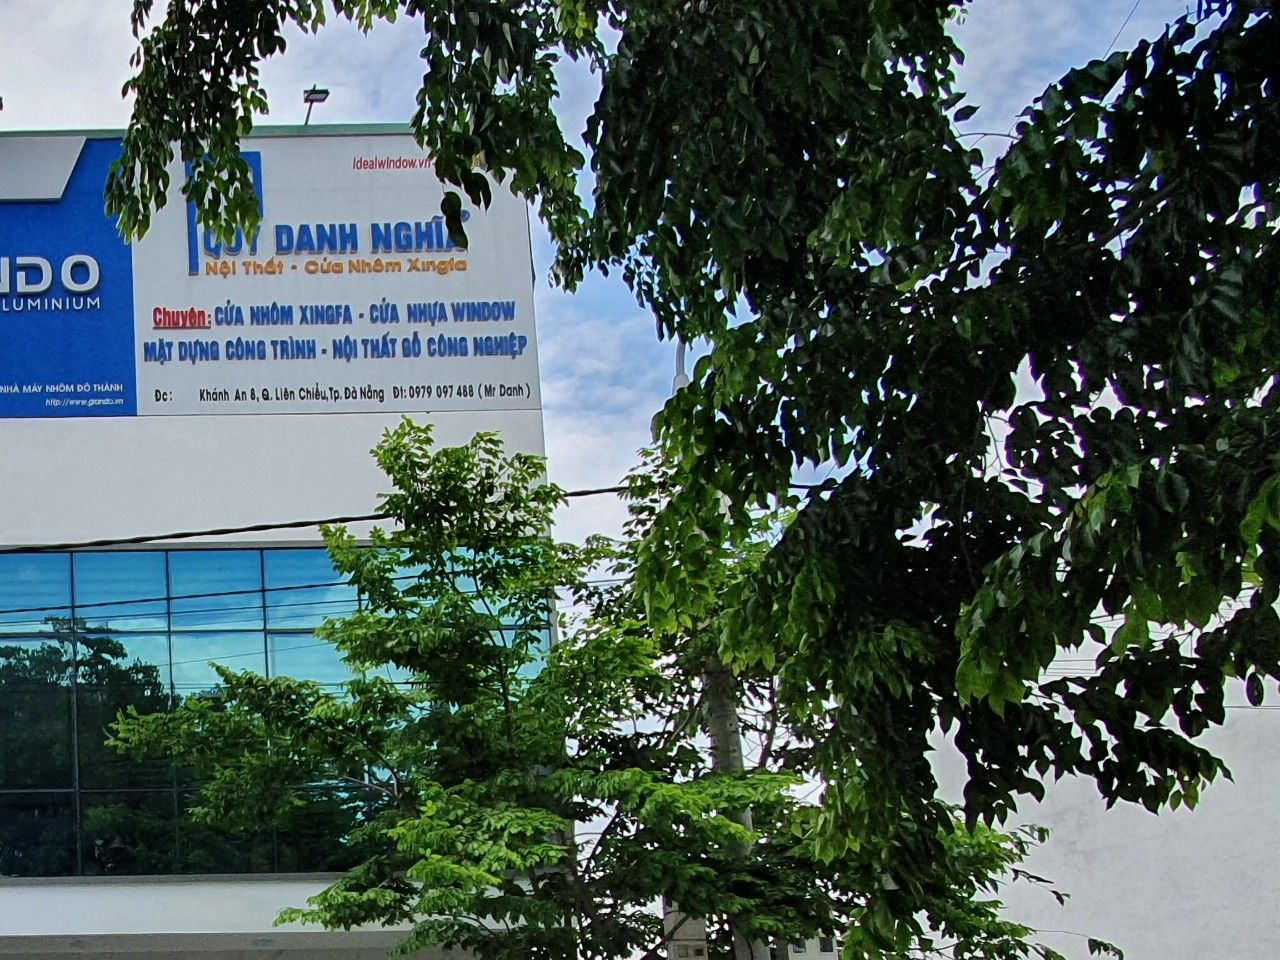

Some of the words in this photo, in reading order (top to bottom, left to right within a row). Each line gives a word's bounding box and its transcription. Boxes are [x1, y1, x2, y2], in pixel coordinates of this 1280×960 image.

[275, 223, 358, 255] DANH
[371, 216, 468, 252] NGHĨ
[206, 260, 236, 278] Nội
[242, 256, 284, 275] Thất
[304, 257, 344, 275] Cửa
[349, 258, 402, 274] Nhôm
[407, 258, 467, 275] Xingfa
[153, 306, 211, 329] Chuyên:
[214, 299, 244, 326] CỬA
[250, 302, 294, 325] NHÔM
[299, 303, 352, 325] XINGFA
[370, 297, 399, 323] CỬA
[407, 301, 448, 327] NHỰA
[451, 301, 516, 322] WINDOW
[143, 338, 173, 365] MẶT
[178, 339, 220, 365] DỰNG
[225, 336, 267, 361] CÔNG
[270, 335, 317, 359] TRÌNH
[332, 334, 358, 363] NỘI
[361, 331, 397, 359] THẤT
[427, 332, 469, 358] CÔNG
[473, 332, 528, 360] NGHIỆP
[45, 382, 74, 393] NHÔM
[199, 387, 229, 402] Khánh
[234, 388, 247, 401] An
[275, 387, 296, 401] Liên
[344, 386, 357, 400] Đà
[409, 385, 432, 399] 0979
[436, 385, 453, 399] 097
[457, 384, 474, 398] 488
